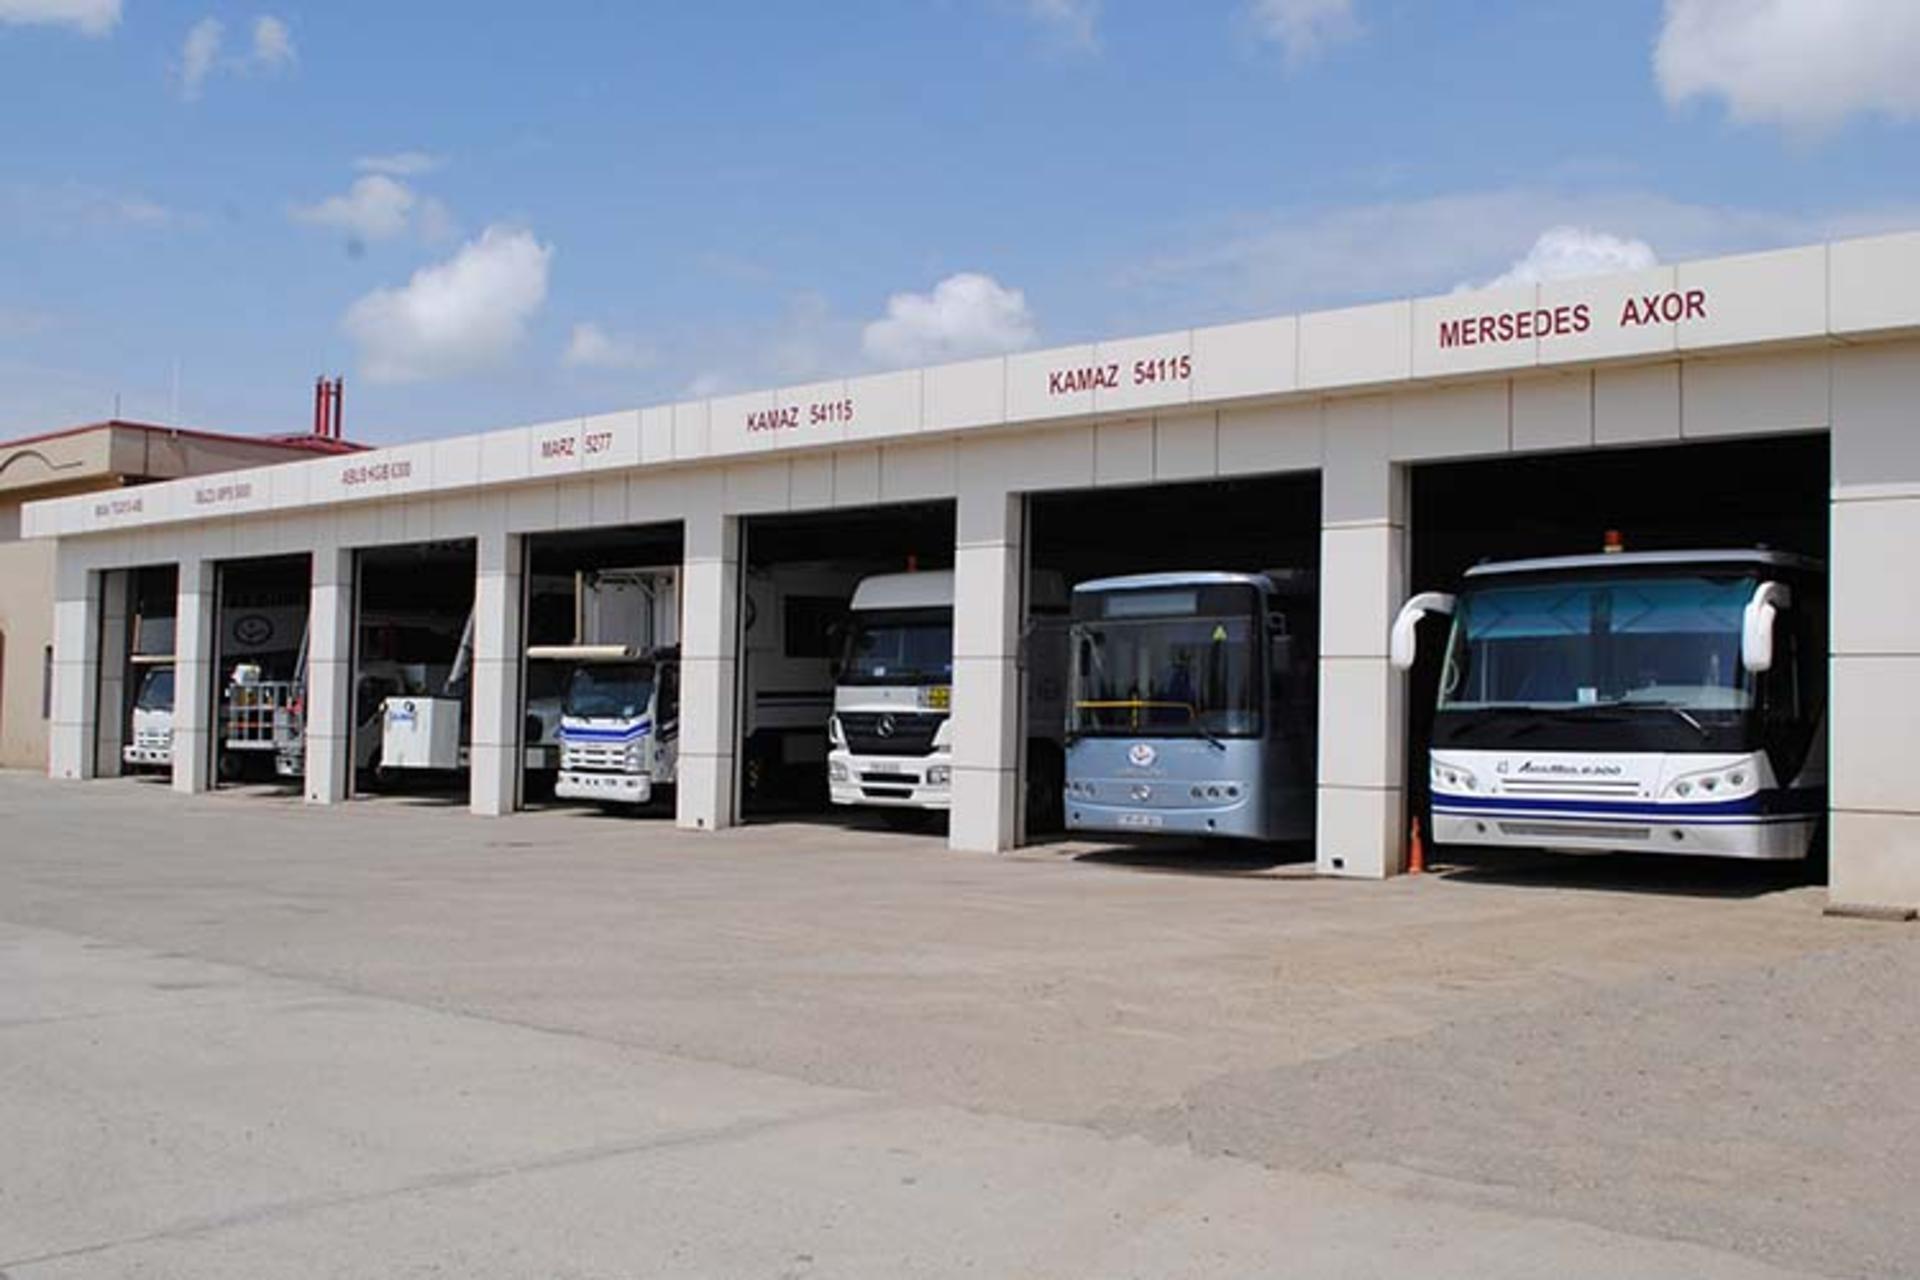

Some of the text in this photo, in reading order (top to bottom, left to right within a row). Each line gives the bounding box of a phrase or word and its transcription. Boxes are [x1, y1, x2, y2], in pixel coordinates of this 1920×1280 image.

[1438, 289, 1706, 349] MERSEDES AXOR
[1049, 355, 1191, 394] KAMAZ 54115
[747, 399, 853, 432] KAMAZ 54115
